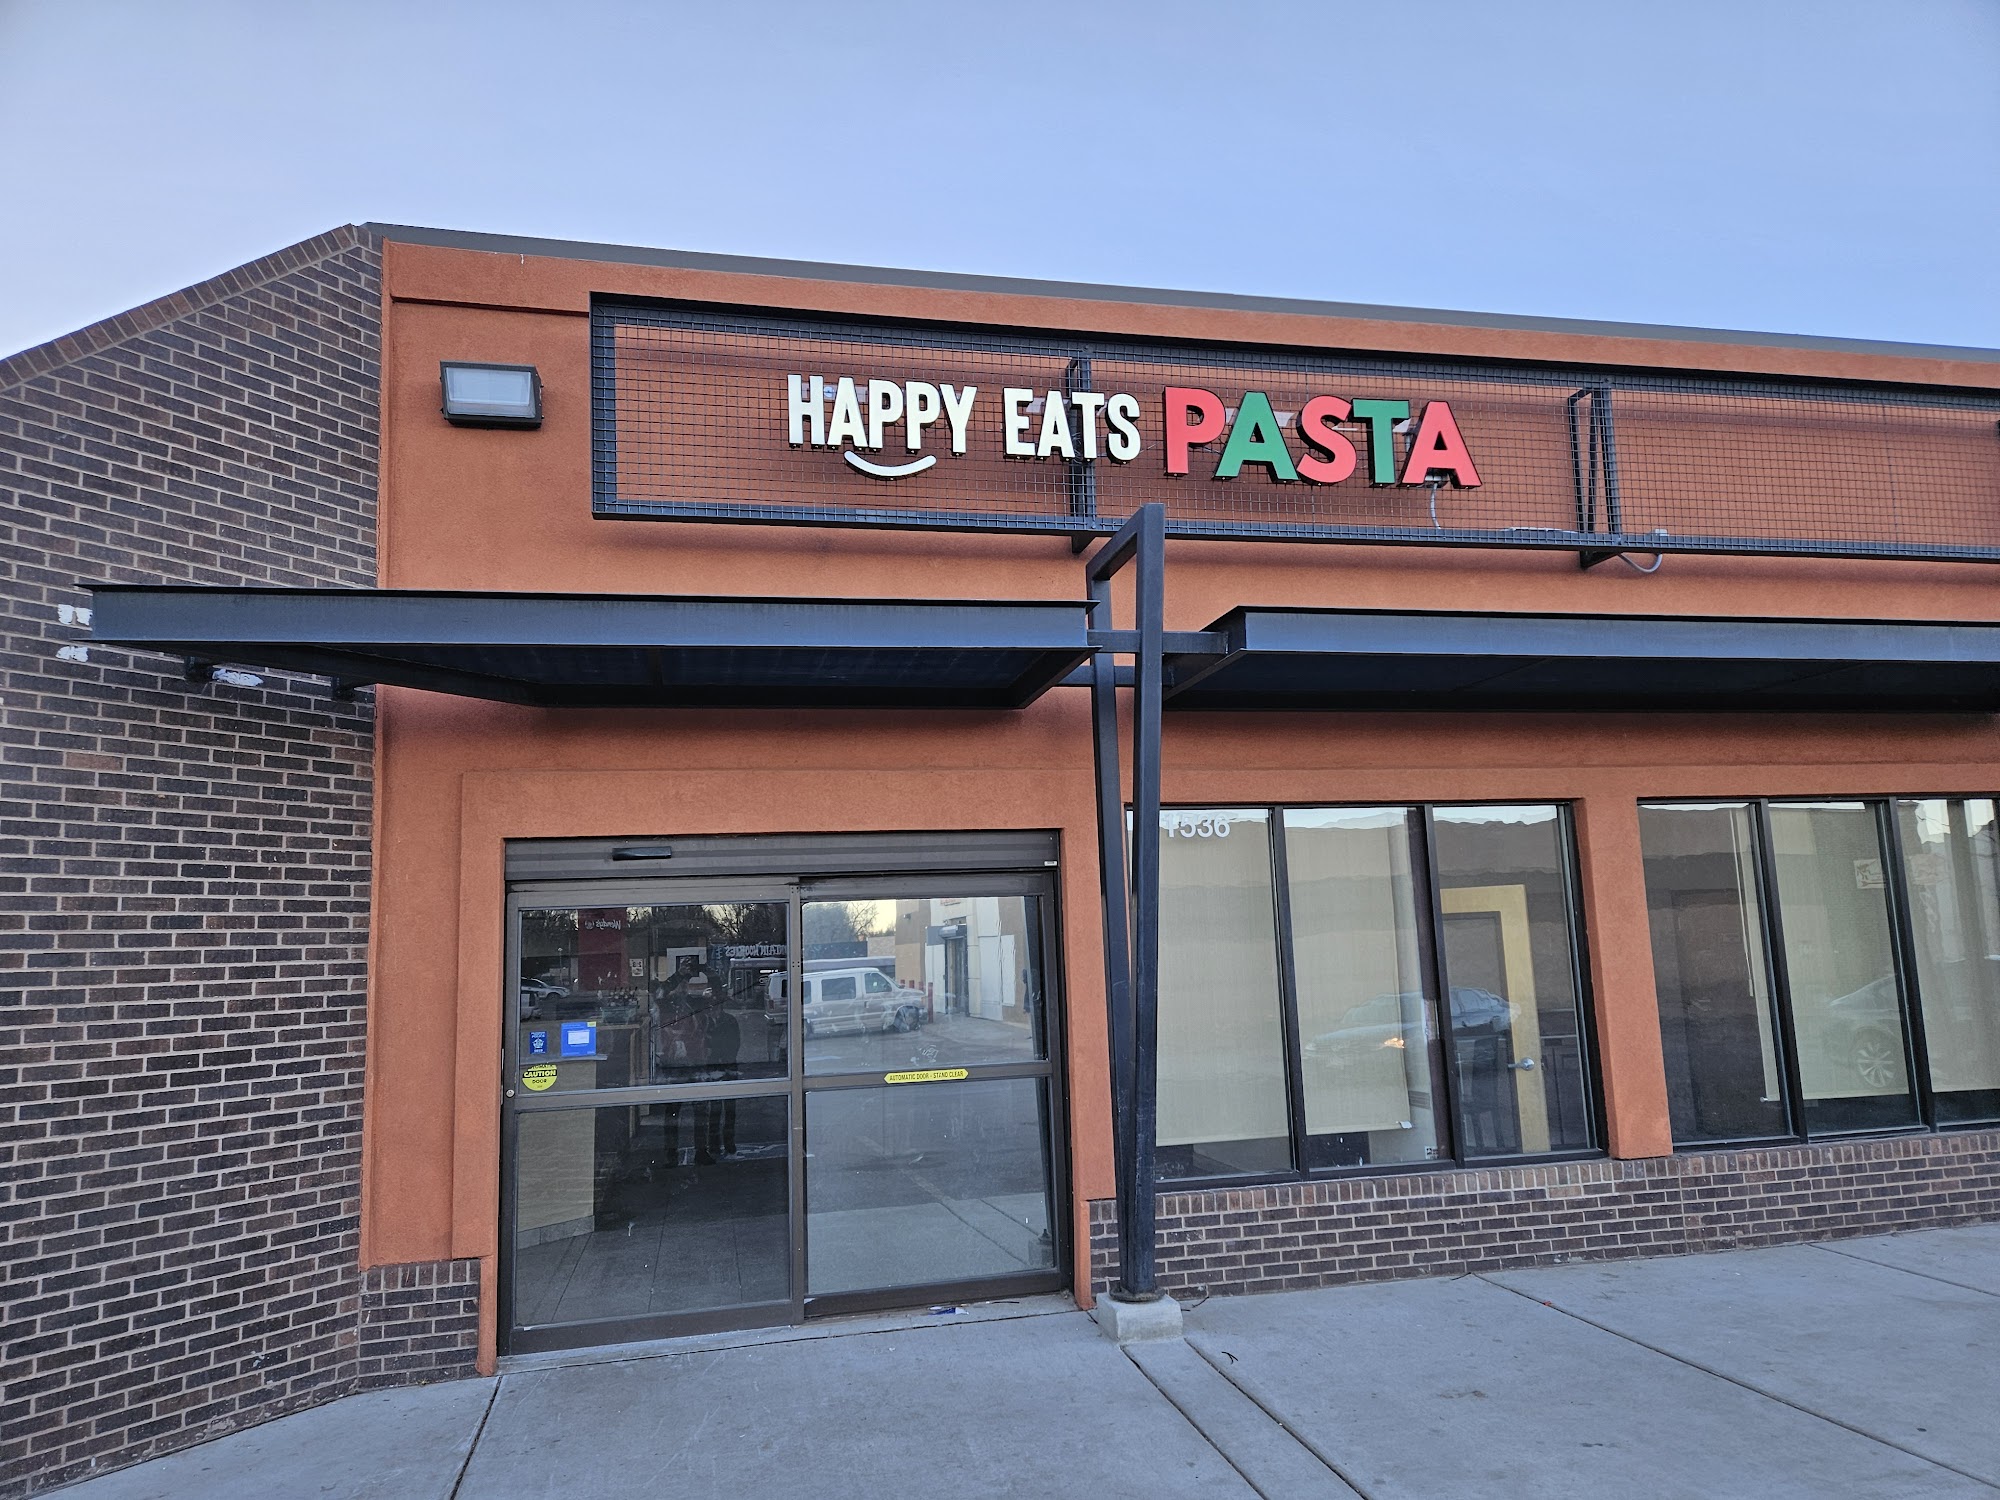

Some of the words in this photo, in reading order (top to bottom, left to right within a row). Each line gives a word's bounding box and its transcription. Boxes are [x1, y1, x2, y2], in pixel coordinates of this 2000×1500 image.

[787, 374, 978, 456] HAPPY
[1003, 387, 1141, 462] EATS
[1164, 386, 1483, 488] PASTA
[1166, 813, 1231, 838] 1536
[524, 1070, 556, 1078] CAUTION
[889, 1073, 915, 1082] AUTOMATIC
[916, 1072, 929, 1080] DOOR
[933, 1071, 948, 1079] STAND
[949, 1070, 964, 1078] CLEAR
